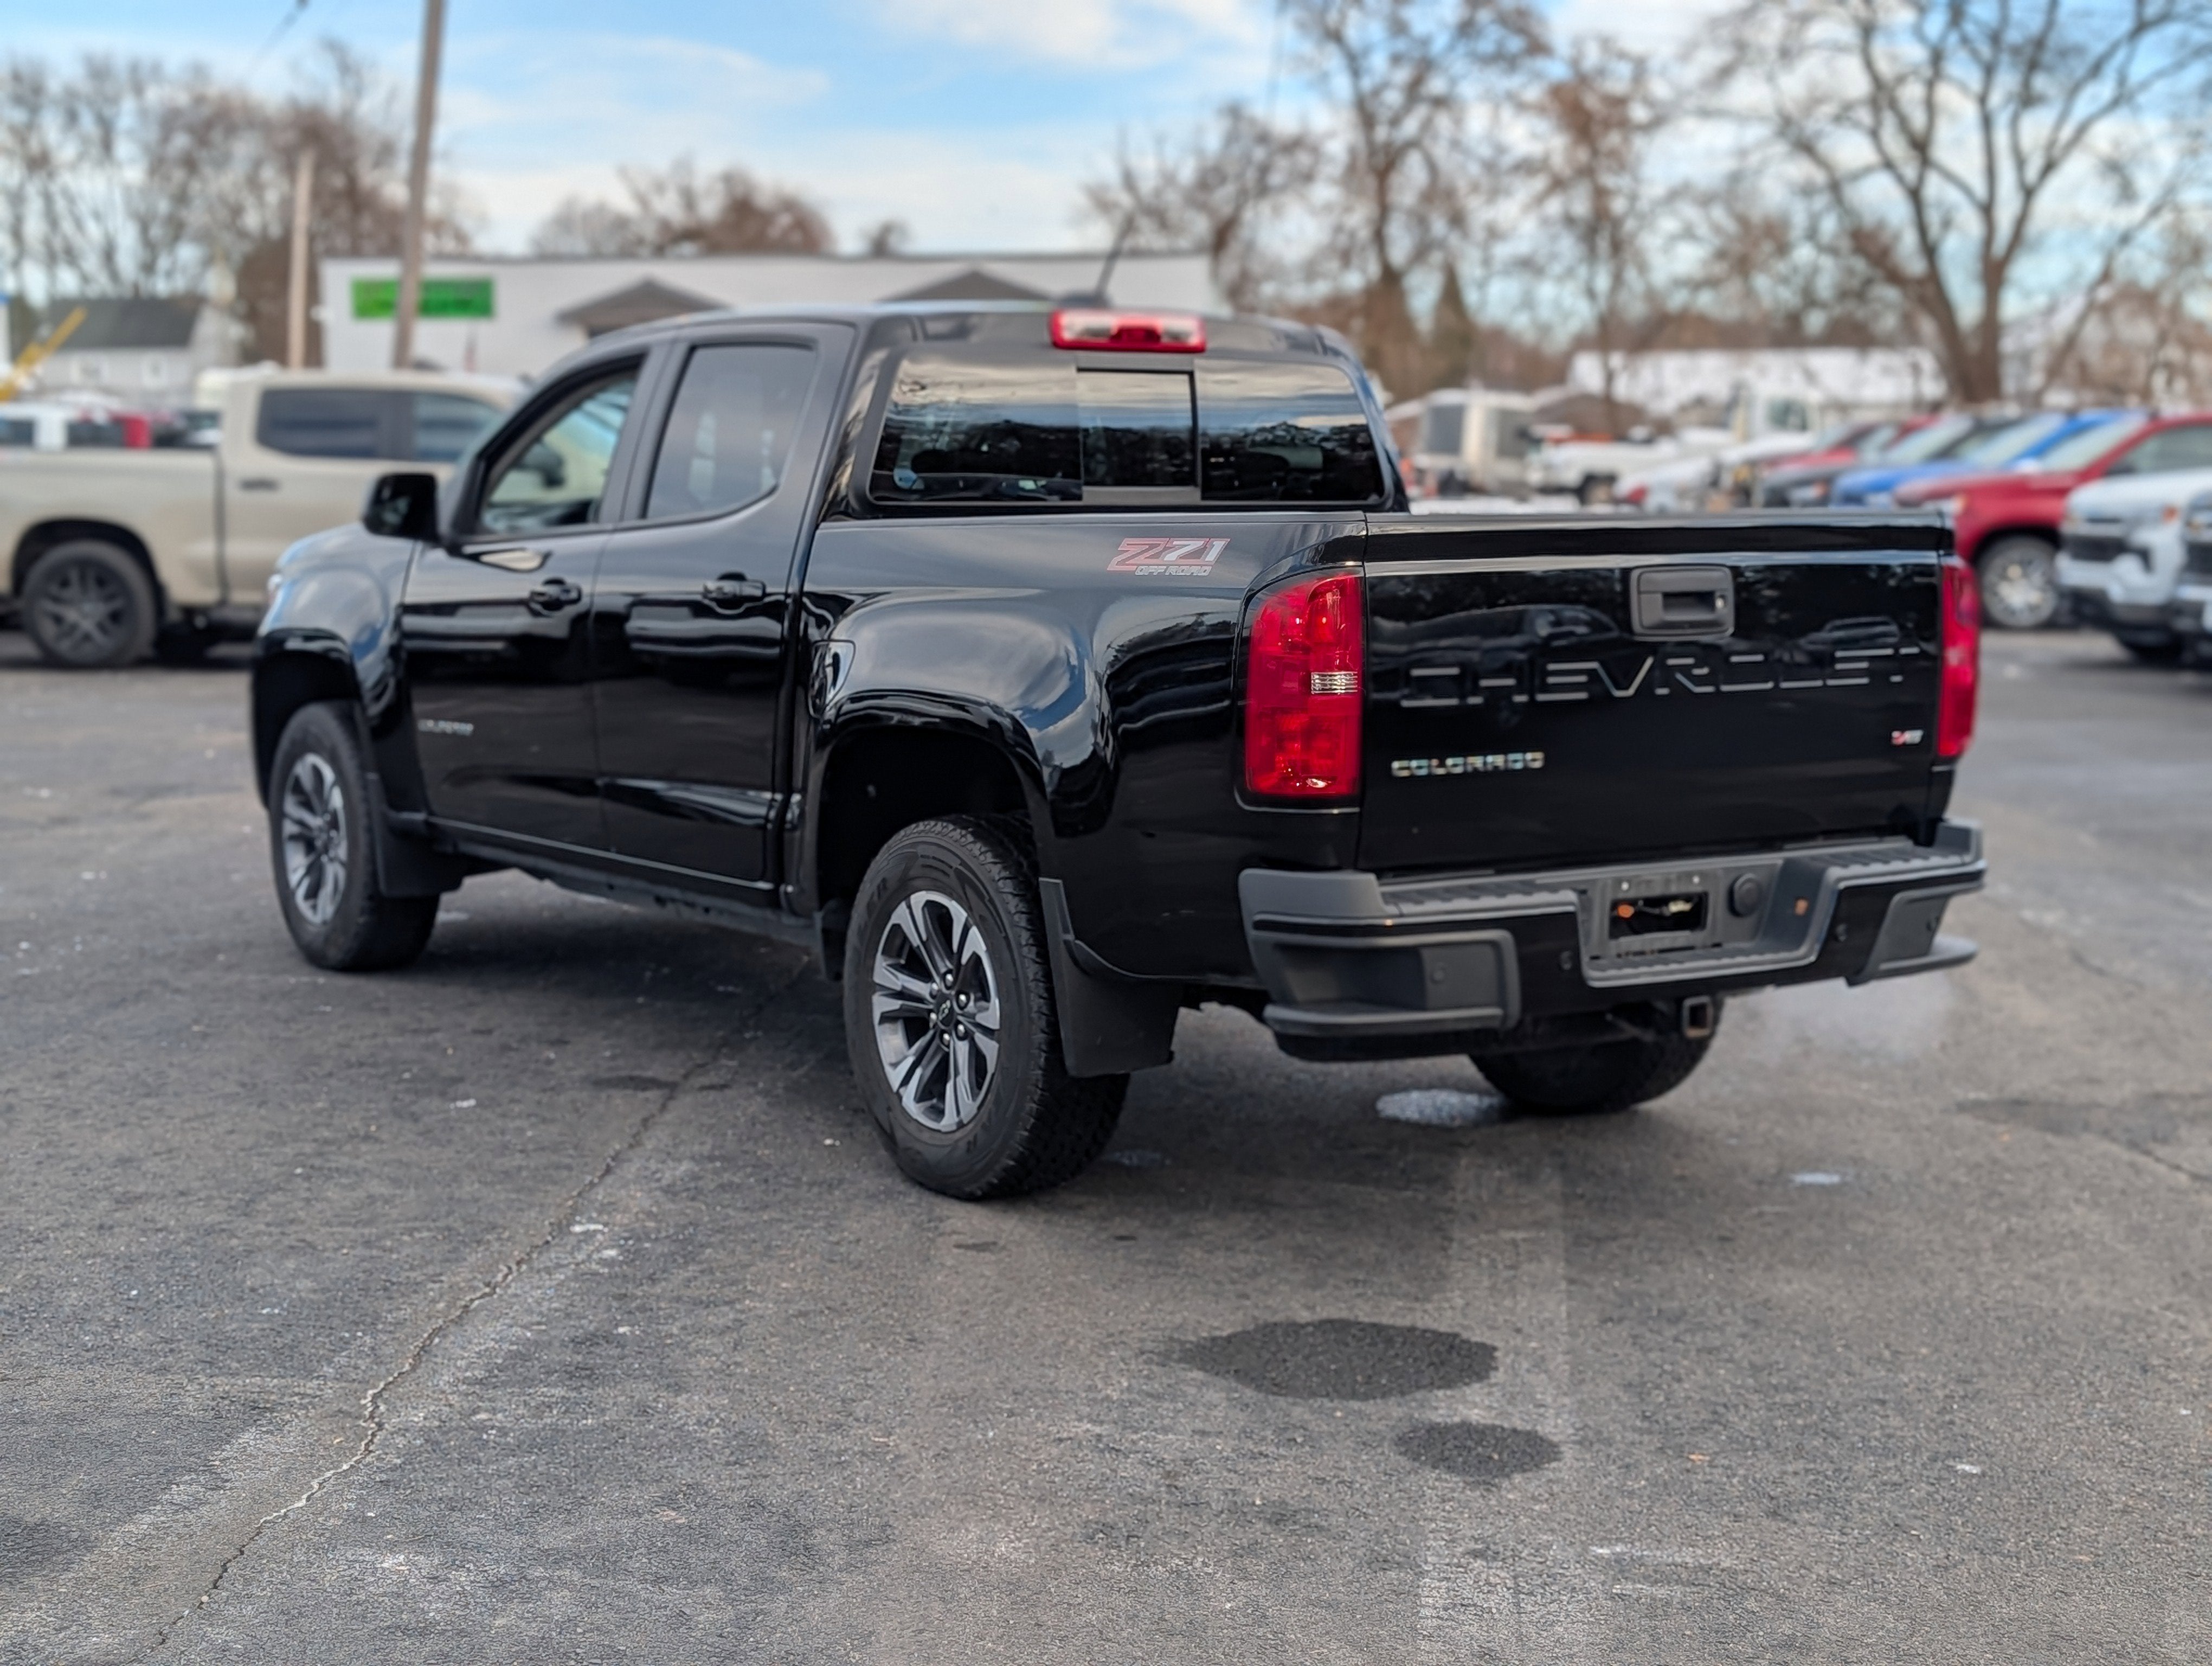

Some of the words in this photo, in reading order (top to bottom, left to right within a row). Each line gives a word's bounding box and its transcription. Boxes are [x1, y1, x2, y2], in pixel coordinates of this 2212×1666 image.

[1107, 537, 1231, 571] Z71
[1135, 566, 1166, 575] OFF
[1166, 566, 1212, 576] ROAD
[1399, 646, 1921, 708] CHEVROLET
[1391, 752, 1545, 777] COLORADO
